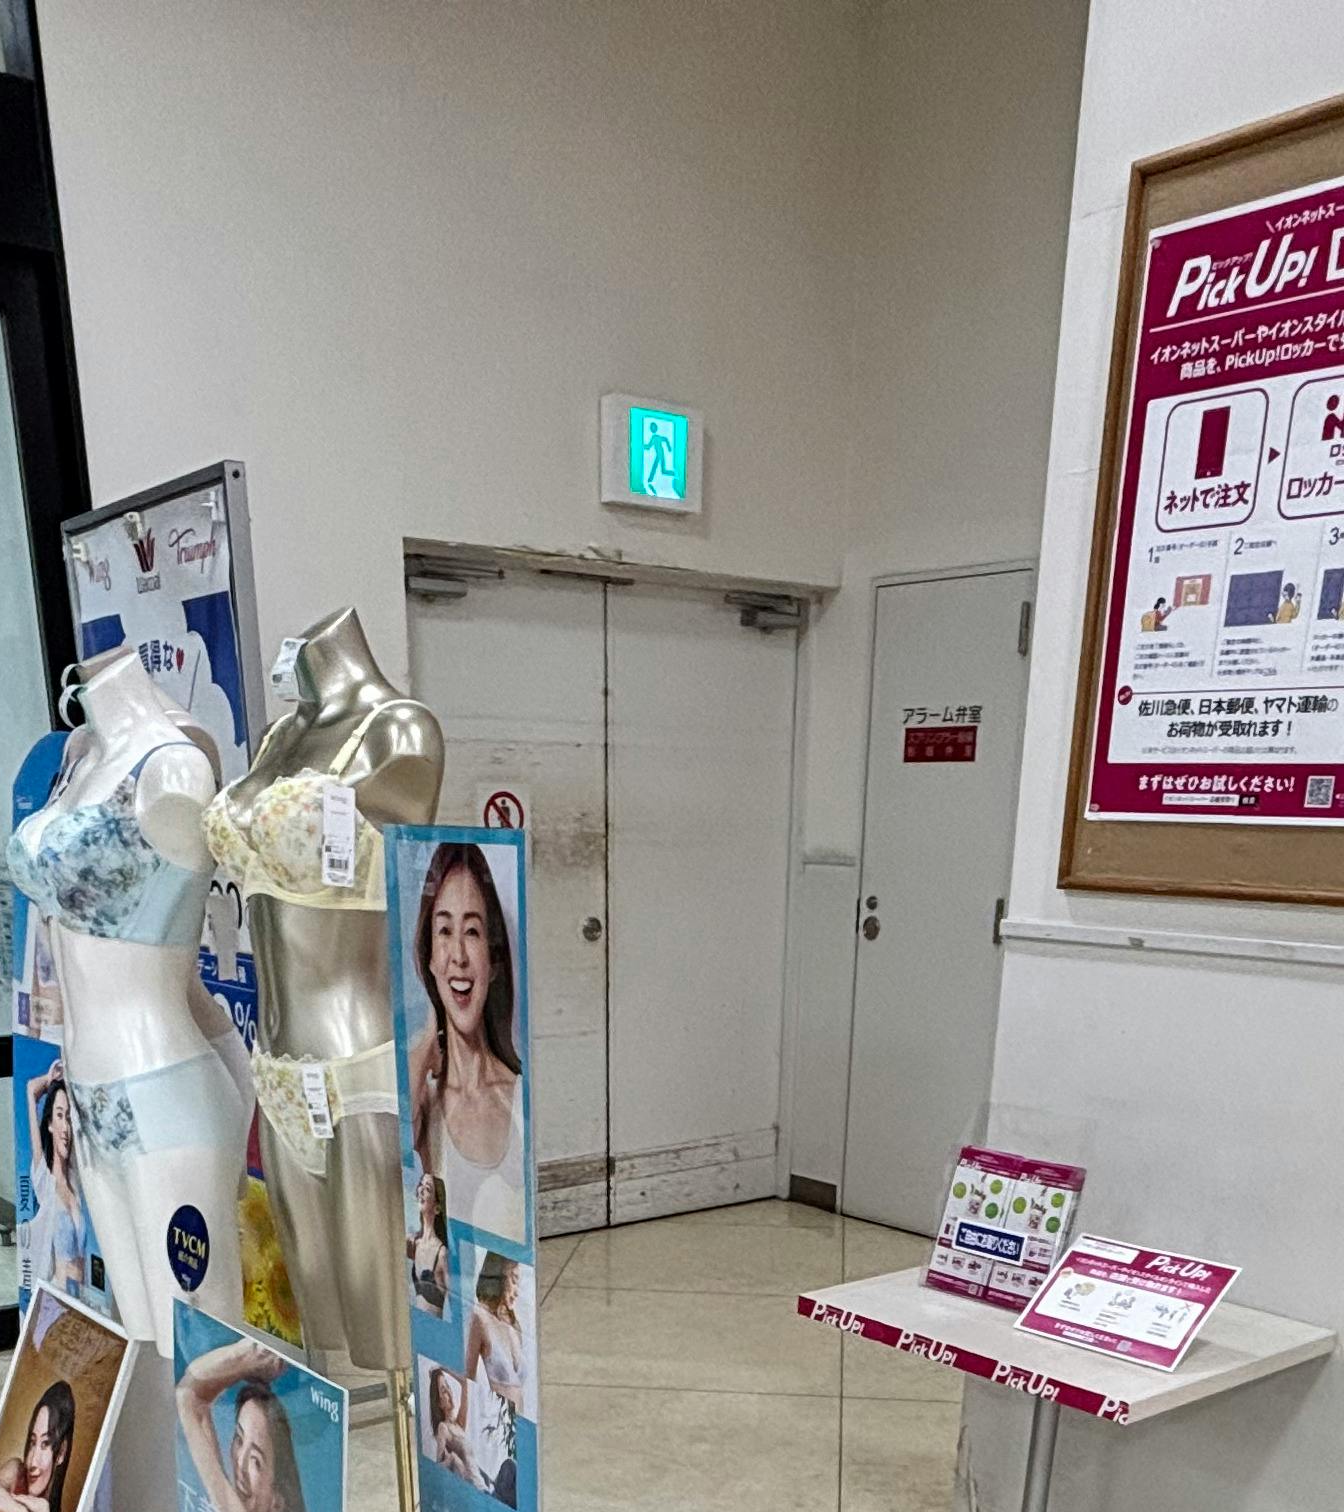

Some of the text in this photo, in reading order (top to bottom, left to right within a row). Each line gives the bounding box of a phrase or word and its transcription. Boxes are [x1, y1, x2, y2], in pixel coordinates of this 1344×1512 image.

[1163, 481, 1251, 515] ネットで注文
[1328, 527, 1340, 545] 3
[1233, 537, 1245, 556] 2
[902, 705, 983, 724] アラーム弁室
[1138, 695, 1339, 717] 佐川急便、日本郵便、ヤマト運輸の
[1167, 720, 1293, 738] お荷物が受取れます!
[1138, 774, 1296, 793] まずはぜひお試しください!
[173, 1226, 206, 1260] TVCM
[310, 1386, 339, 1423] Wing
